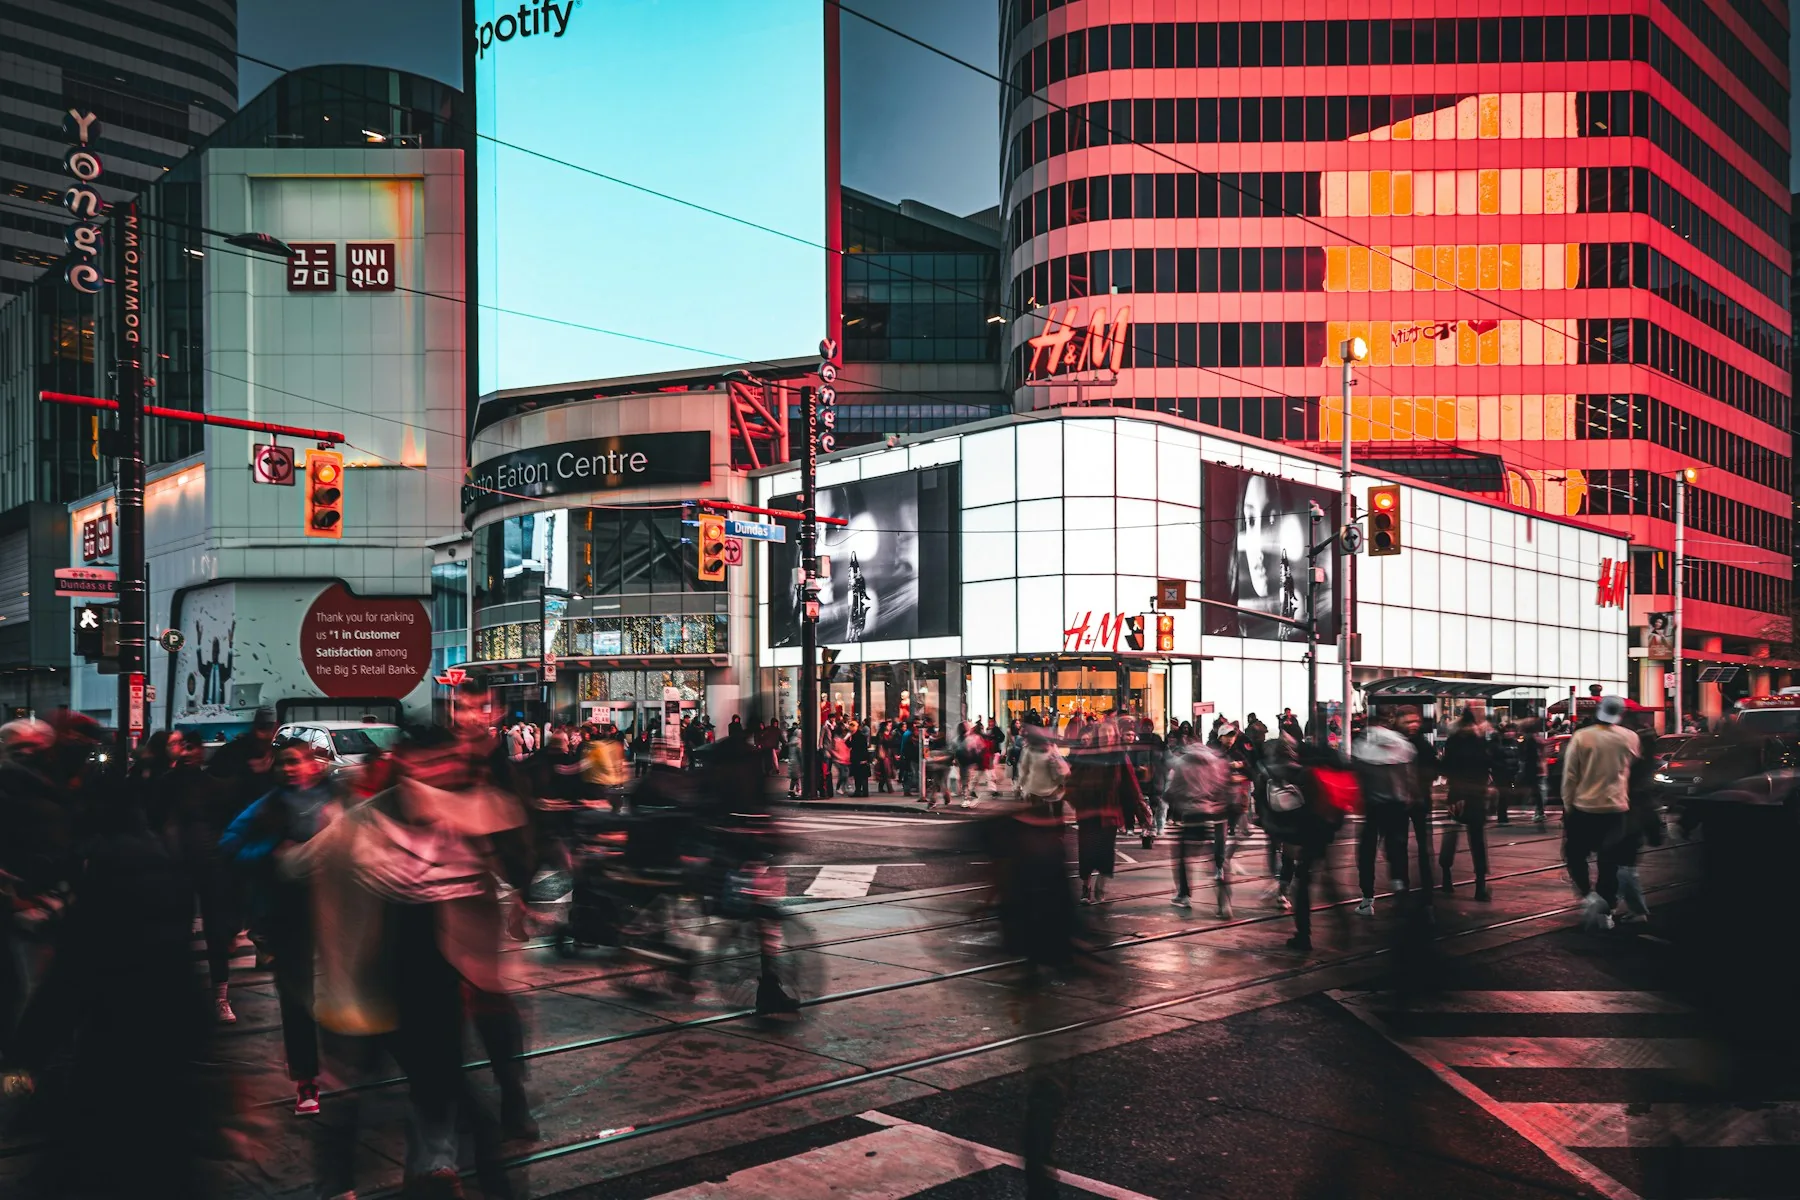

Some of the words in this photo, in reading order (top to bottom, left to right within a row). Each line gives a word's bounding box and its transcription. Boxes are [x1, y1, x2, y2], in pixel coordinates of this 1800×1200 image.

[475, 0, 574, 60] potify
[352, 249, 385, 266] UNI
[125, 215, 139, 343] DOWNTOWN
[352, 268, 389, 288] QLO
[1028, 305, 1131, 375] H&M
[809, 394, 817, 476] DOWNTOWN
[497, 461, 549, 491] Eaton
[556, 449, 649, 479] Centre
[734, 522, 769, 537] Dundas
[60, 580, 97, 590] Dundas
[107, 582, 113, 591] E
[316, 612, 343, 622] Thank
[346, 614, 363, 624] you
[365, 612, 378, 622] for
[380, 612, 415, 624] ranking
[169, 634, 179, 645] P
[316, 631, 327, 640] us
[342, 630, 352, 640] in
[354, 630, 400, 640] Customer
[1063, 611, 1125, 652] H&M
[316, 648, 373, 657] Satisfaction
[375, 649, 407, 659] among
[316, 665, 332, 675] the
[334, 665, 349, 677] Big
[352, 665, 358, 675] 5
[360, 665, 386, 675] Retail
[388, 665, 418, 675] Banks.
